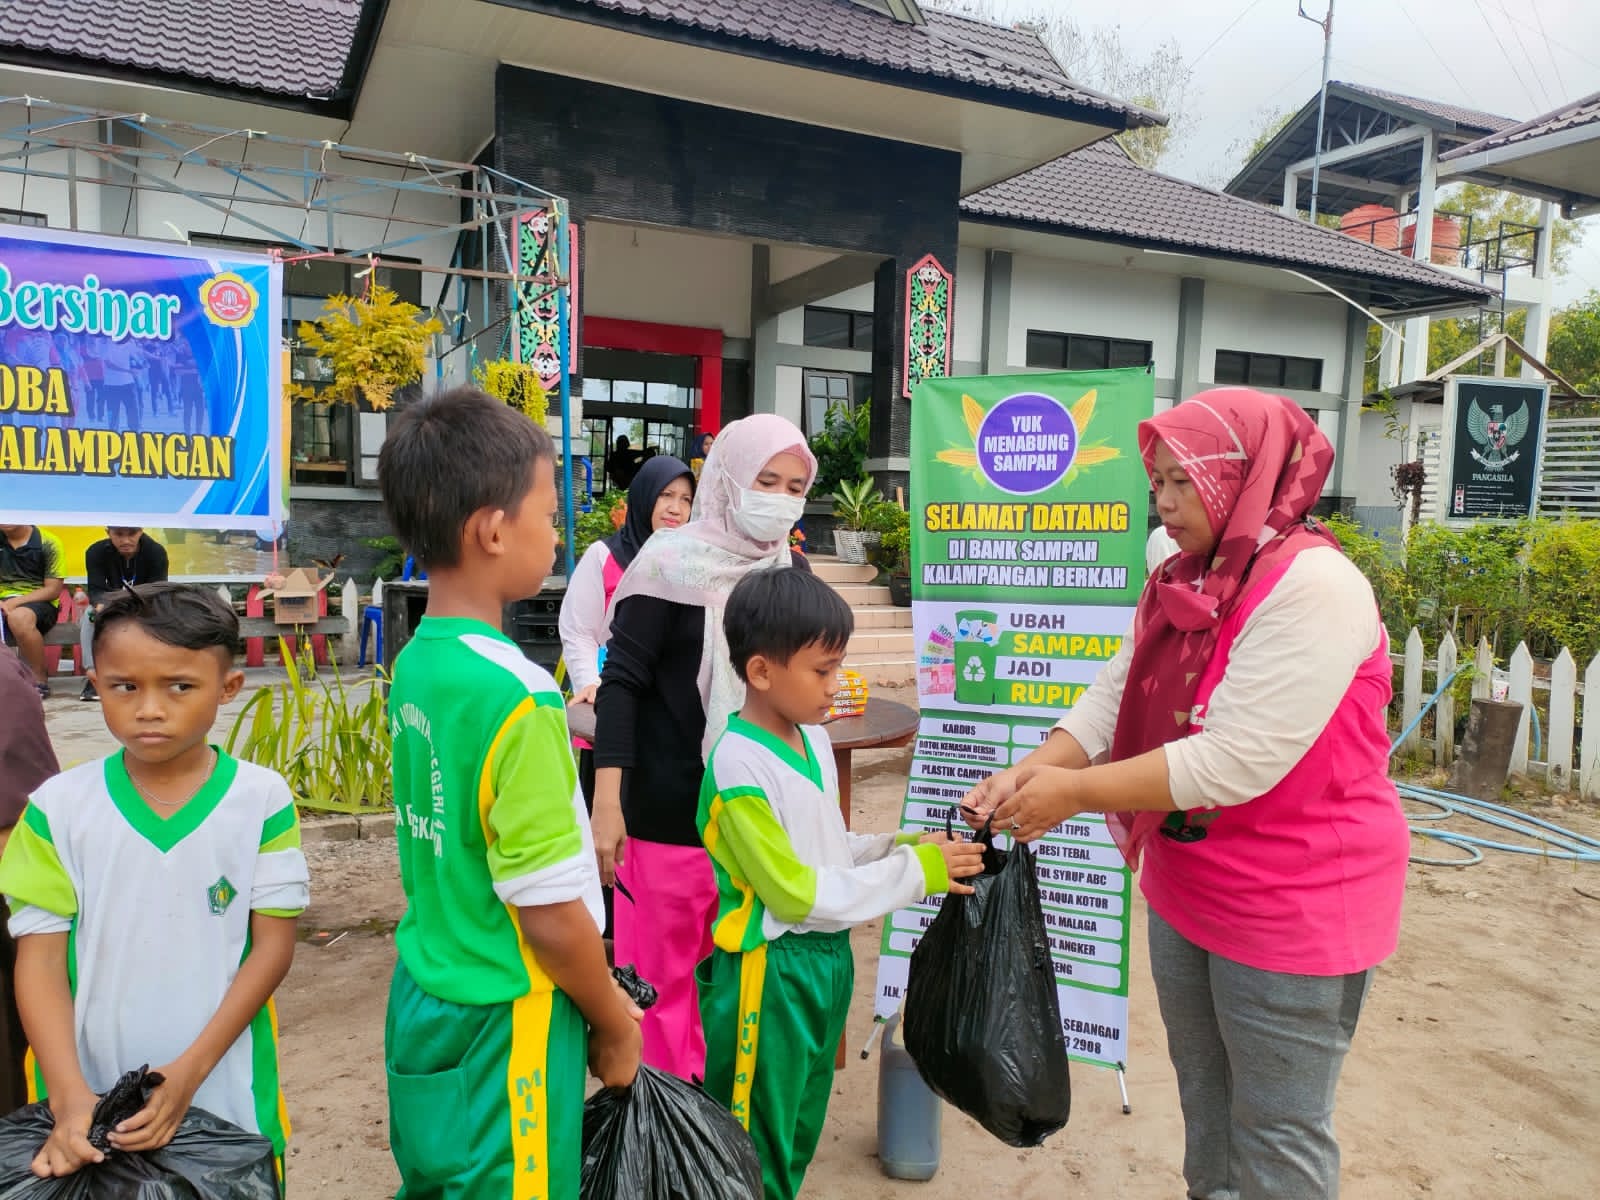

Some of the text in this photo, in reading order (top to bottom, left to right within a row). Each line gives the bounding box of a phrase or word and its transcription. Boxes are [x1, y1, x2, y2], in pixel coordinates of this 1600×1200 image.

[1011, 415, 1043, 433] YUK
[984, 433, 1069, 453] MENABUNG
[993, 454, 1058, 472] SAMPAH
[1471, 473, 1514, 482] PANCASILA
[926, 503, 1129, 533] SELAMAT DATANG
[948, 539, 1098, 562] DI BANK SAMPAH
[923, 564, 1128, 589] KALAMPANGAN BERKAH
[1010, 612, 1065, 629] UBAH
[1013, 634, 1121, 657] SAMPAH
[1008, 660, 1051, 677] JADI
[942, 723, 976, 736] KARDUS
[940, 742, 972, 753] KEMASAN
[972, 744, 996, 755] BERSIH
[921, 764, 956, 777] PLASTIK
[1065, 824, 1090, 837] TIPIS
[1039, 844, 1091, 860] BESI TEBAL
[1053, 869, 1085, 882] SYRUP
[1086, 873, 1107, 886] ABC
[1049, 890, 1074, 905] AQUA
[1076, 895, 1109, 909] KOTOR
[1058, 916, 1097, 932] MALAGA
[1059, 940, 1096, 956] ANGKER
[1063, 1018, 1120, 1041] SEBANGAU
[1072, 1037, 1102, 1055] 2908
